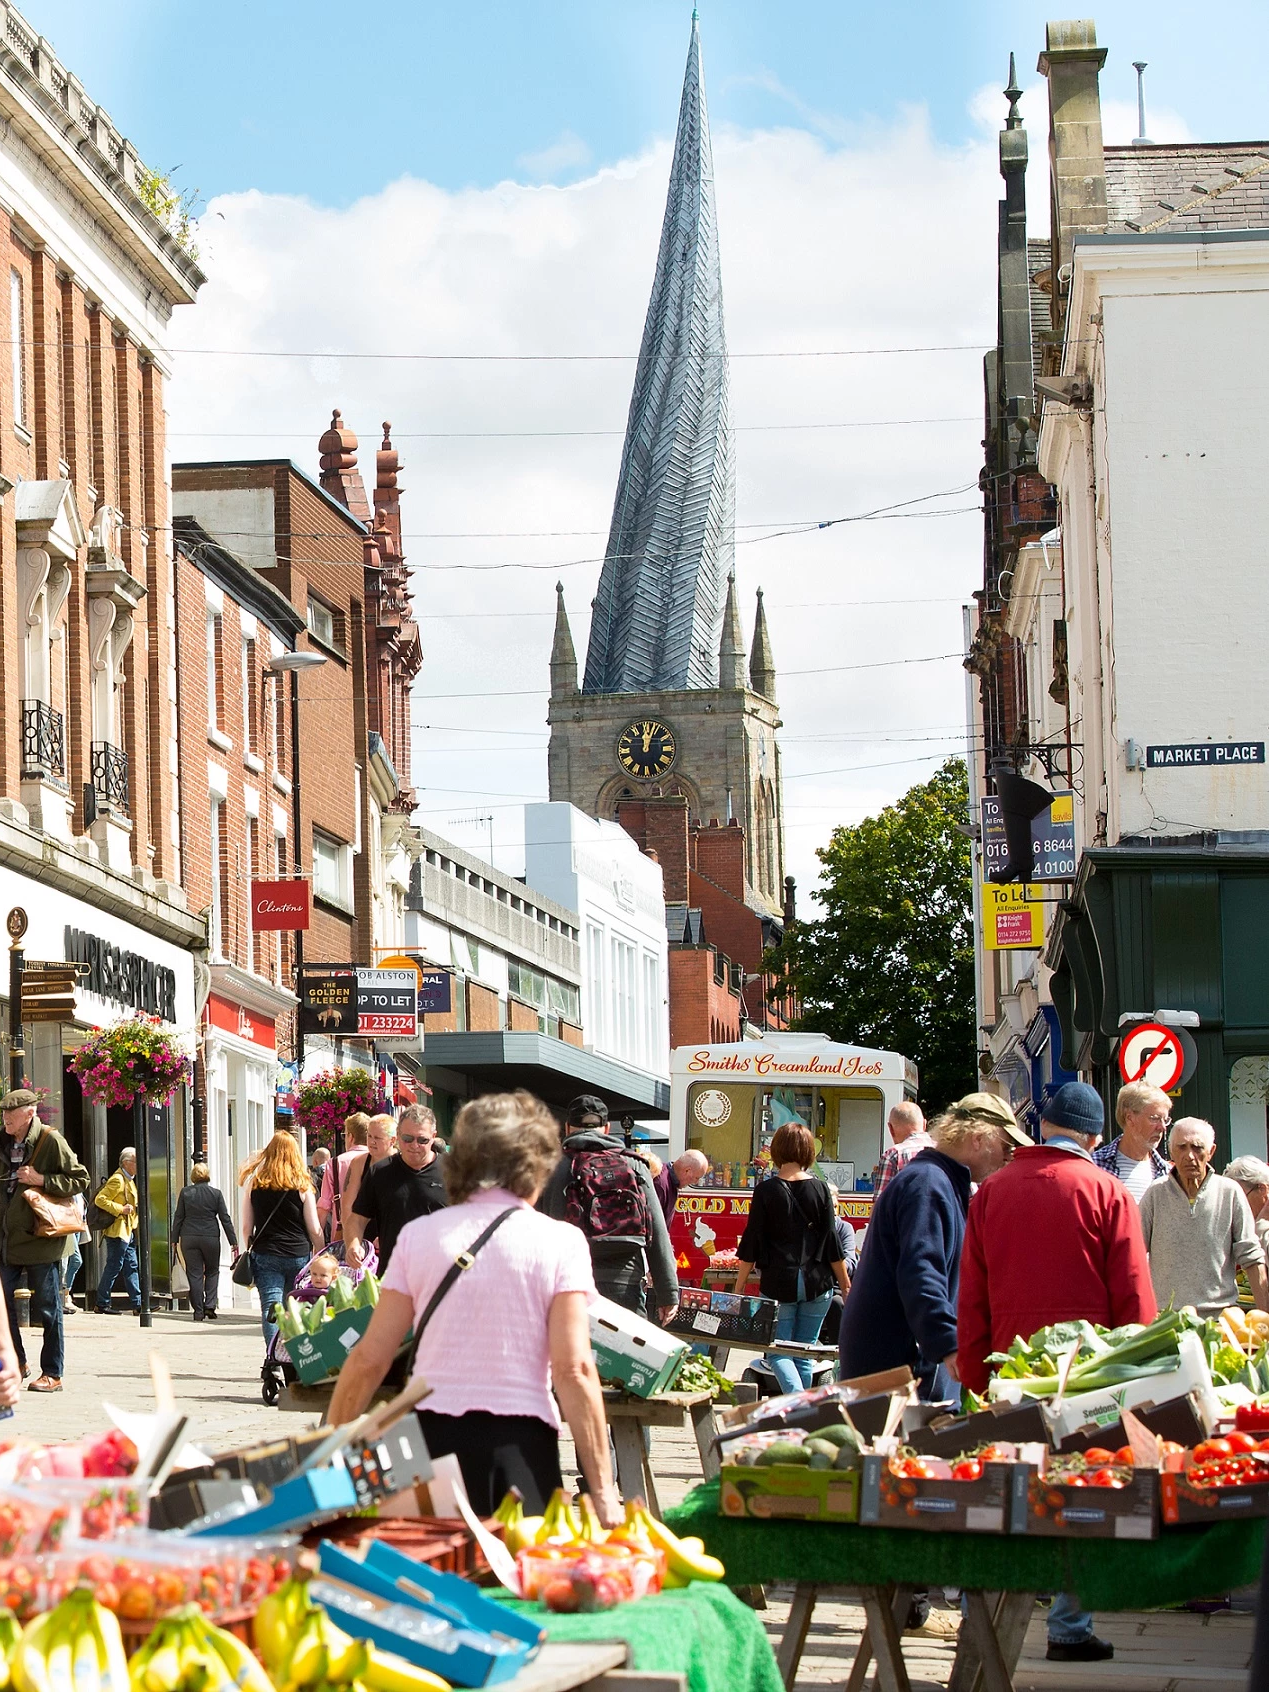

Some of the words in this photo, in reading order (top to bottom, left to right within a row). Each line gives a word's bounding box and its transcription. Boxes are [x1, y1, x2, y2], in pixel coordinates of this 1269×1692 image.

[1153, 749, 1210, 762] MARKET
[1216, 746, 1258, 760] PLACE
[985, 802, 999, 814] To
[1052, 812, 1072, 821] savills
[986, 843, 1009, 857] 016
[1044, 838, 1074, 852] 8644
[1044, 860, 1075, 875] 0100
[992, 889, 1008, 903] To
[257, 899, 304, 914] Clintons
[1005, 904, 1030, 912] Enquiries
[376, 972, 414, 980] ALSTON
[422, 976, 443, 985] RAL
[309, 988, 350, 997] GOLDEN
[310, 997, 349, 1005] FLEECE
[372, 996, 389, 1006] TO
[390, 996, 412, 1007] LET
[372, 1017, 414, 1029] 233224
[688, 1051, 752, 1073] Smiths
[754, 1053, 843, 1076] Creamland
[843, 1056, 884, 1078] Ices
[675, 1197, 726, 1213] GOLD
[730, 1199, 751, 1215] M
[298, 1352, 323, 1369] frusan
[1082, 1403, 1118, 1418] Seddons
